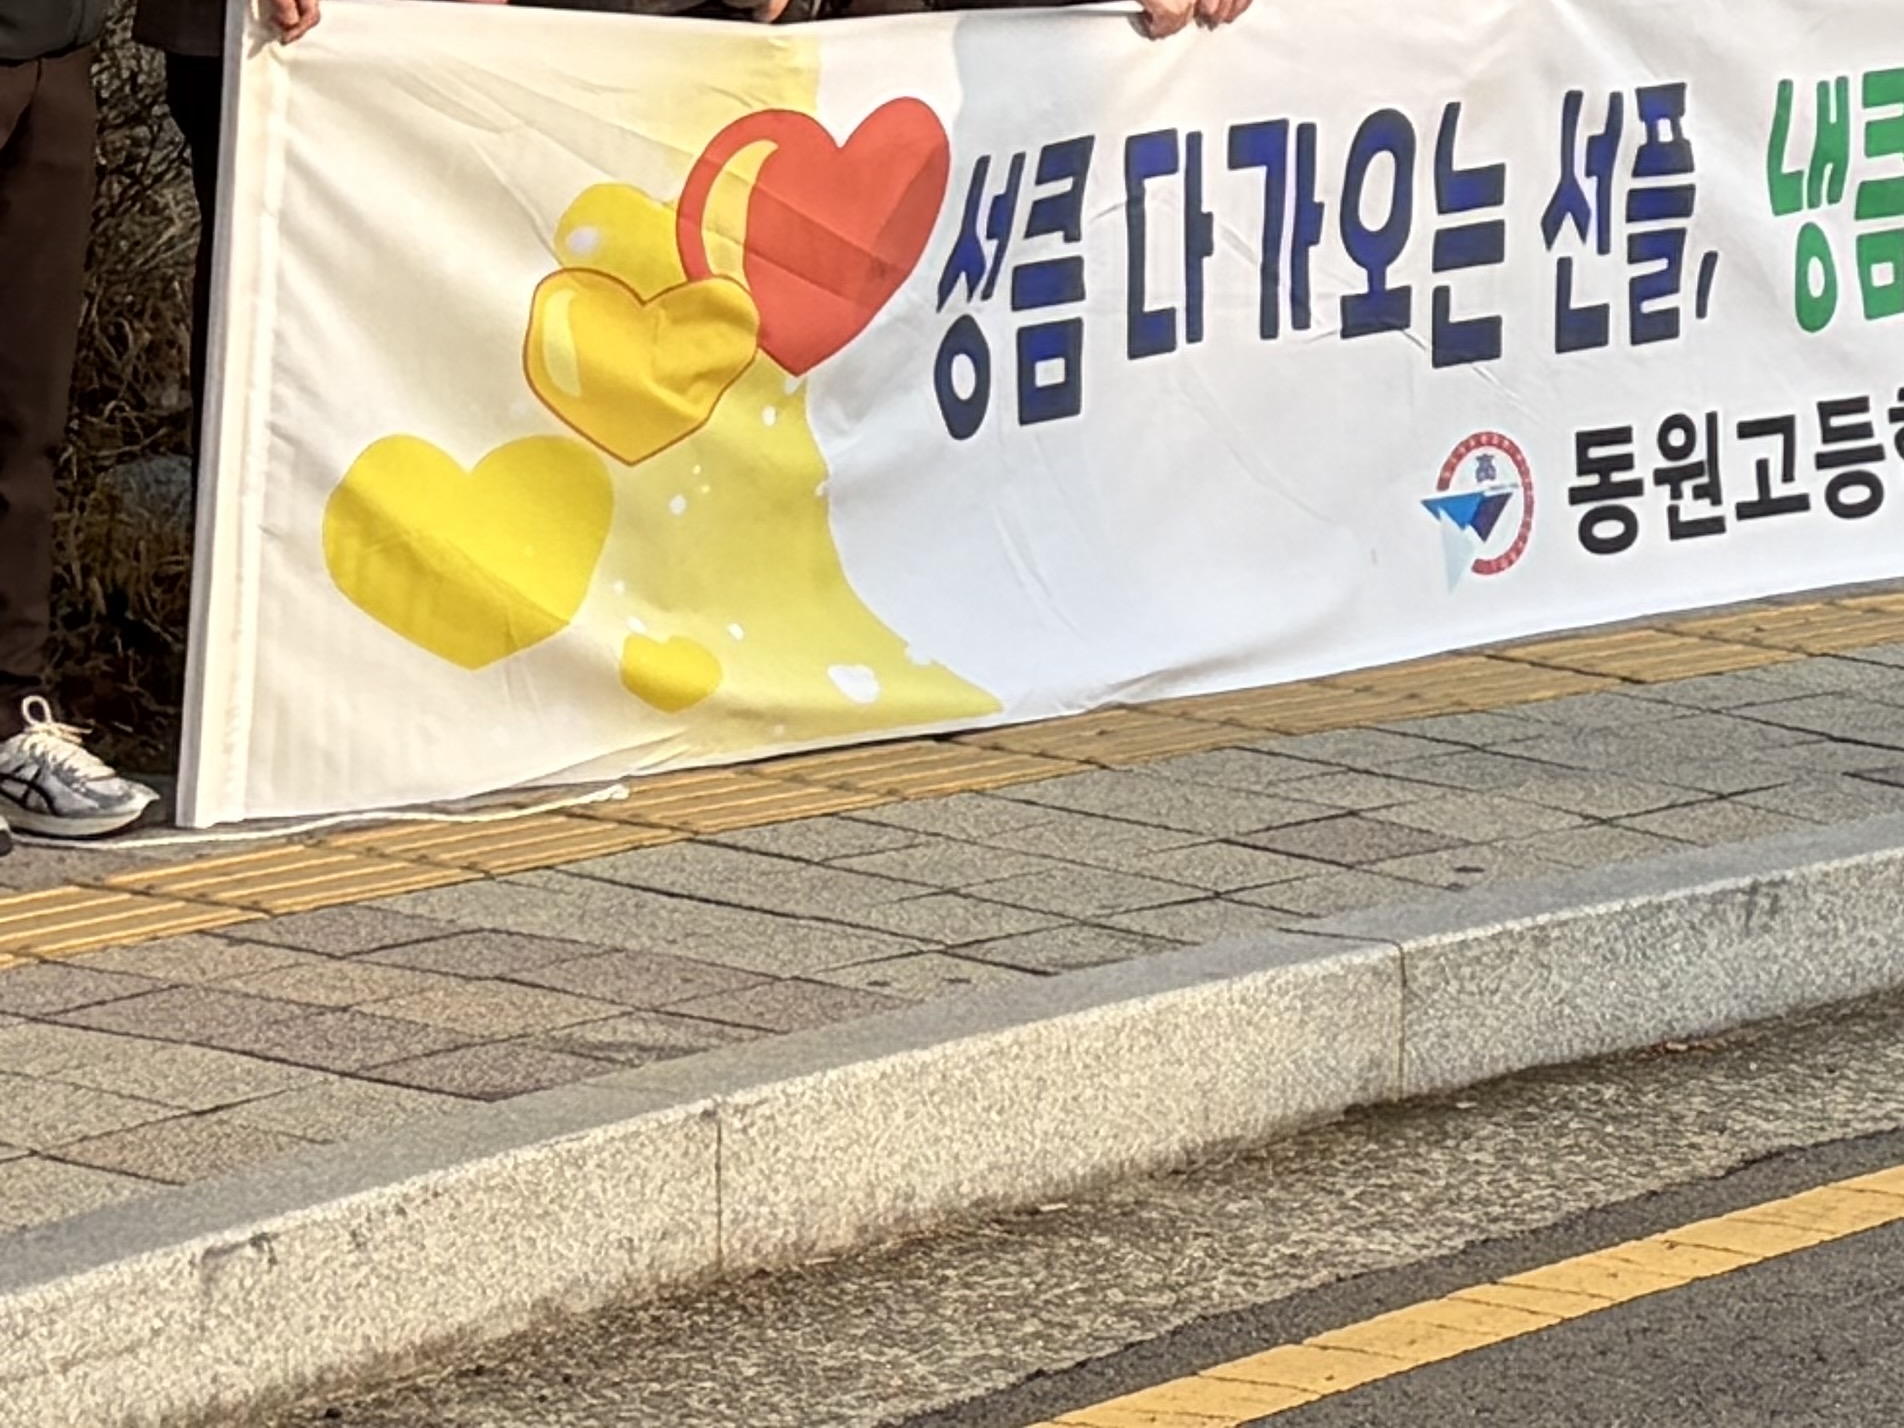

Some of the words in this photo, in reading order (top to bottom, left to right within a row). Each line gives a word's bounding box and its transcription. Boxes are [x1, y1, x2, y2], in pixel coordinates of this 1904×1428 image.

[934, 133, 1096, 440] 성큼
[1123, 100, 1507, 370] 다가오는
[1540, 82, 1719, 355] 선플,
